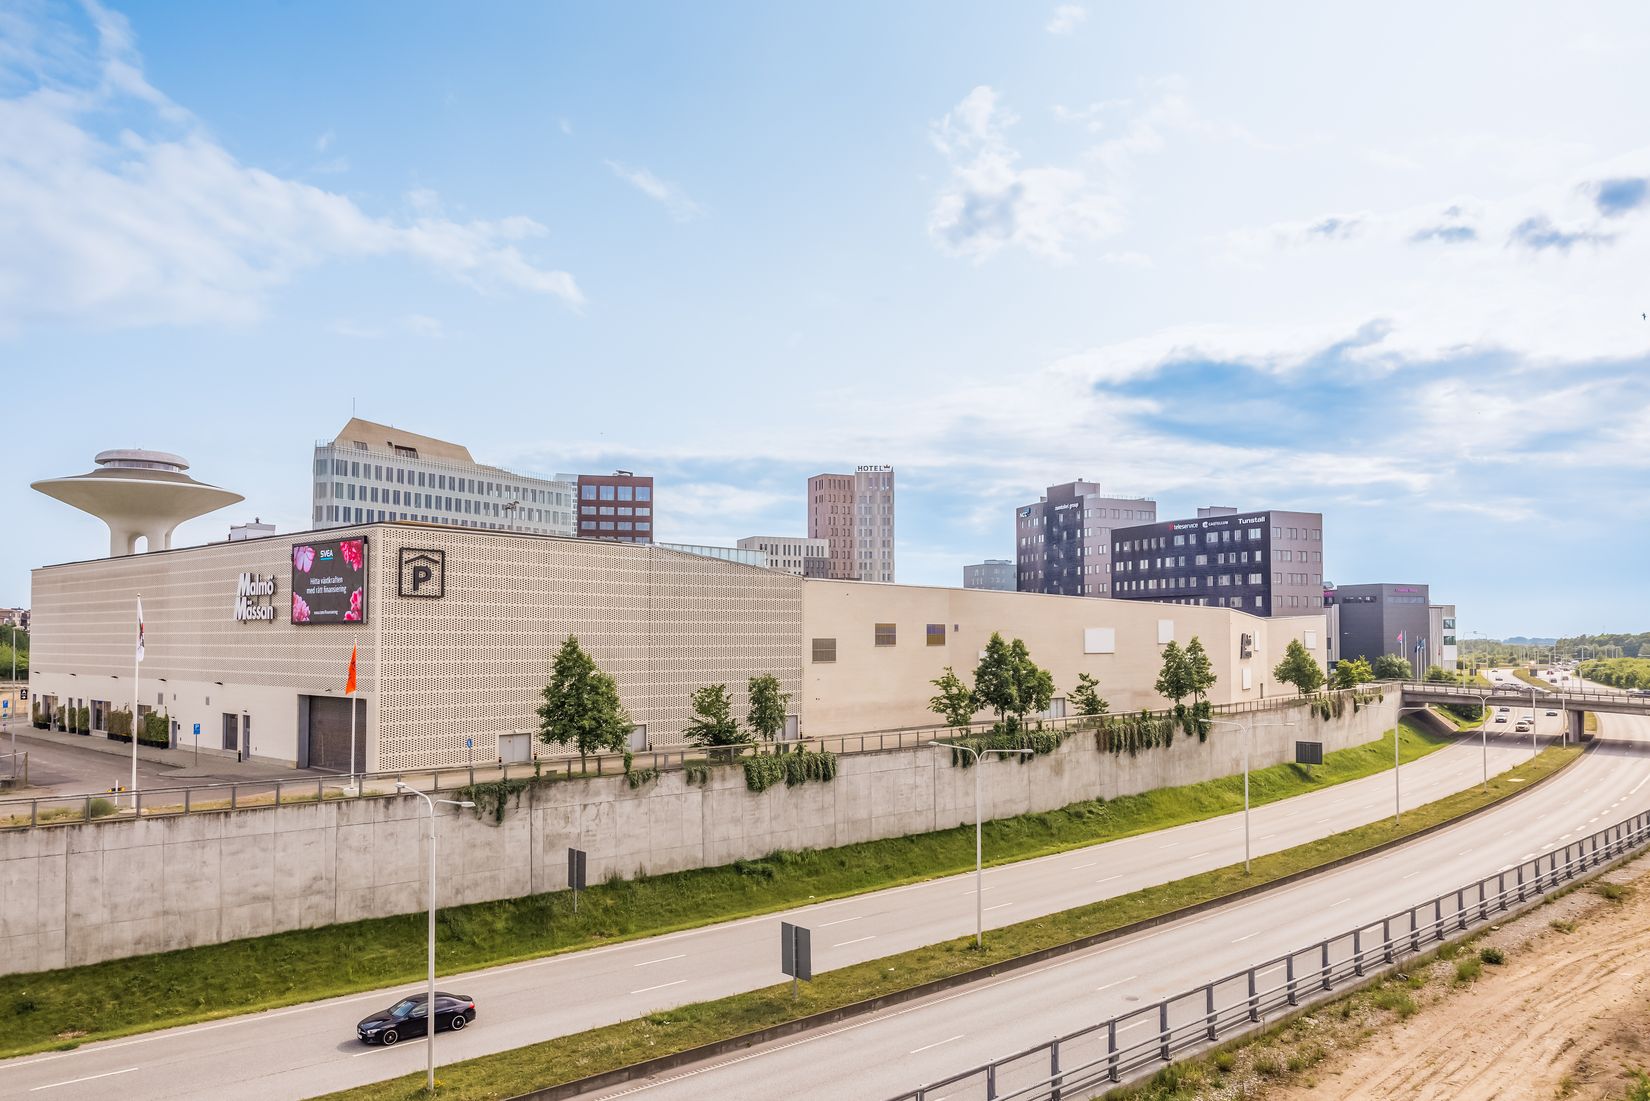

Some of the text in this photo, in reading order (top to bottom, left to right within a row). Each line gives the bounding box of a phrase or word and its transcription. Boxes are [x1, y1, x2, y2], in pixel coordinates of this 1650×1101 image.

[1238, 516, 1265, 524] Tunstall
[320, 549, 333, 558] SVEA
[236, 572, 275, 596] Malmö
[413, 565, 432, 591] P
[306, 585, 347, 594] med rätt finansiering
[234, 596, 274, 620] Mässan
